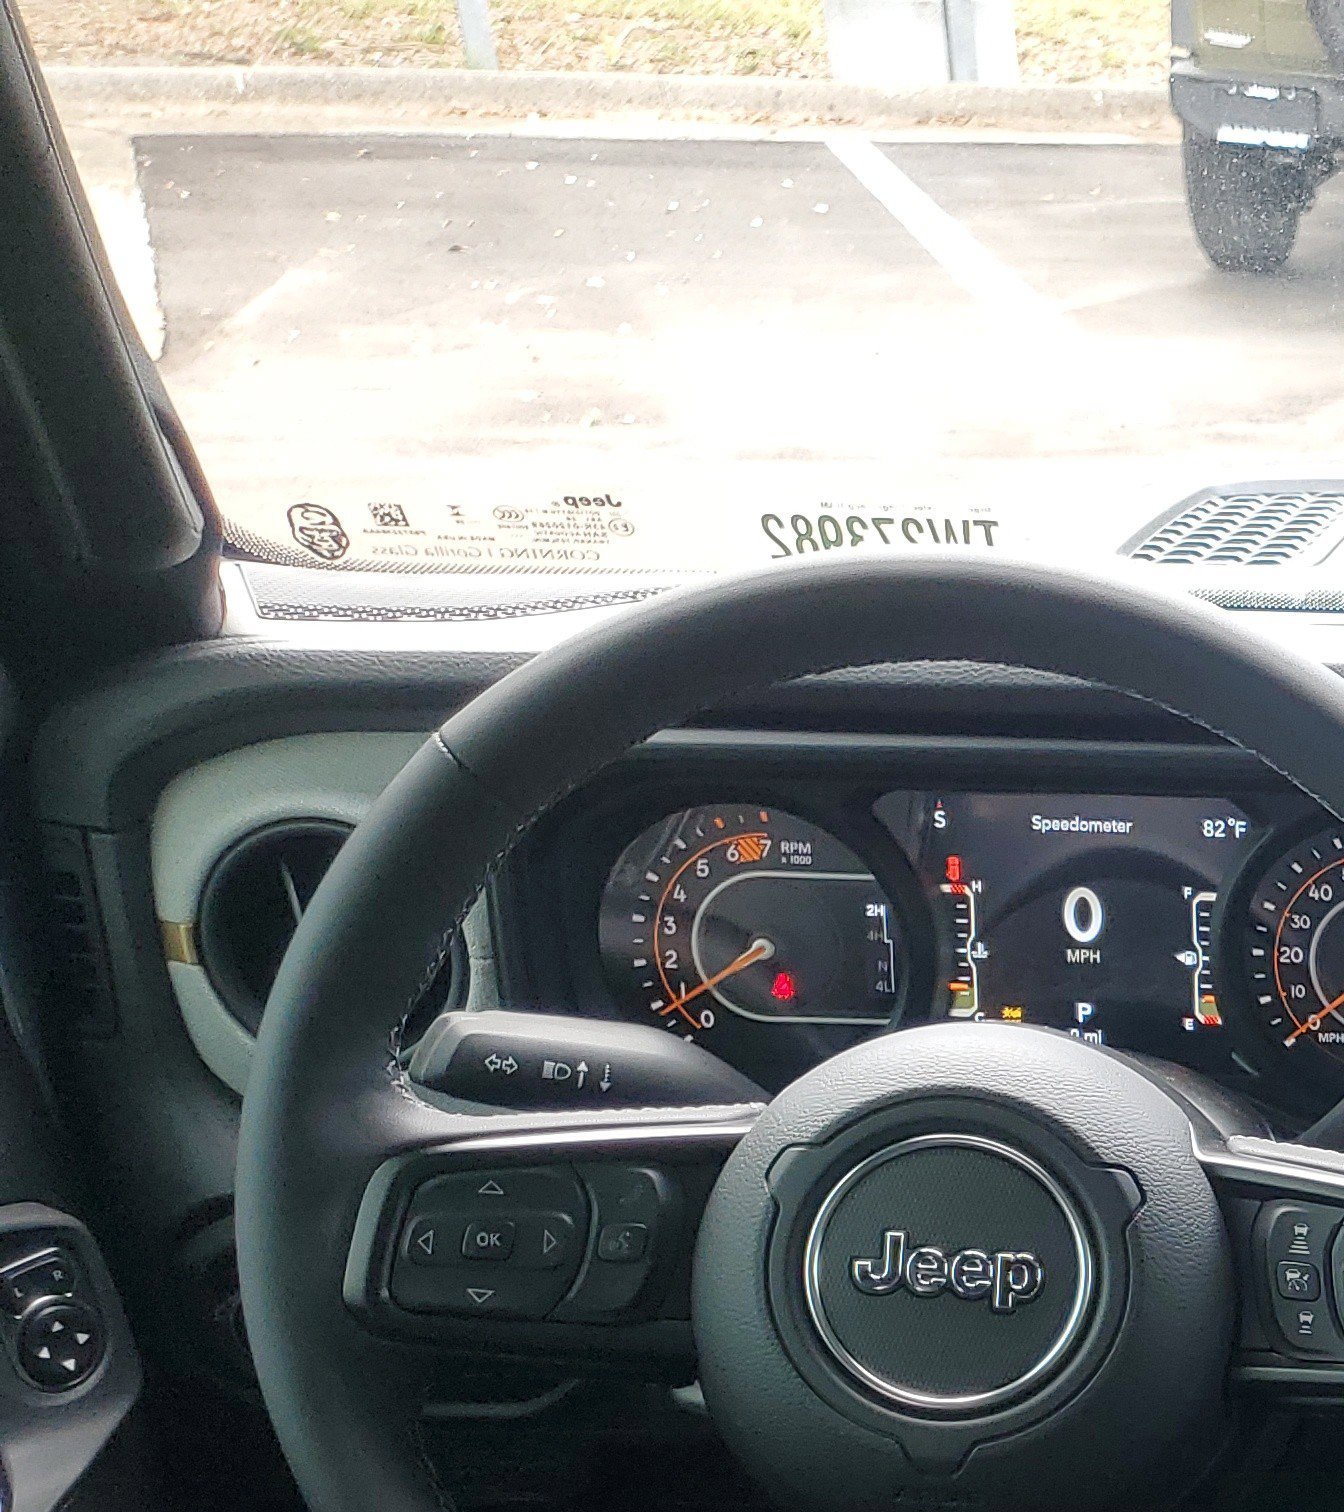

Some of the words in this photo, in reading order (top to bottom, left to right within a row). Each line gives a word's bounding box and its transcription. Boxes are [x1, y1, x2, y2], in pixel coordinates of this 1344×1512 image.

[934, 810, 946, 829] S
[1031, 814, 1133, 835] Speedometer
[1202, 817, 1247, 839] 82°F
[726, 844, 740, 863] 6
[780, 841, 812, 855] RPM
[696, 859, 710, 878] 5
[673, 884, 687, 902] 4
[1308, 884, 1333, 902] 40
[866, 902, 884, 918] 2H
[1063, 887, 1105, 943] 0
[663, 917, 677, 935] 3
[1290, 914, 1311, 930] 30
[665, 950, 679, 969] 2
[1066, 949, 1101, 965] MPH
[1279, 947, 1304, 964] 20
[1290, 984, 1306, 999] 10
[700, 1010, 715, 1030] 0
[1075, 1003, 1094, 1023] P
[1318, 1032, 1344, 1044] MPH
[476, 1231, 502, 1248] OK
[852, 1228, 1046, 1313] Jeep
